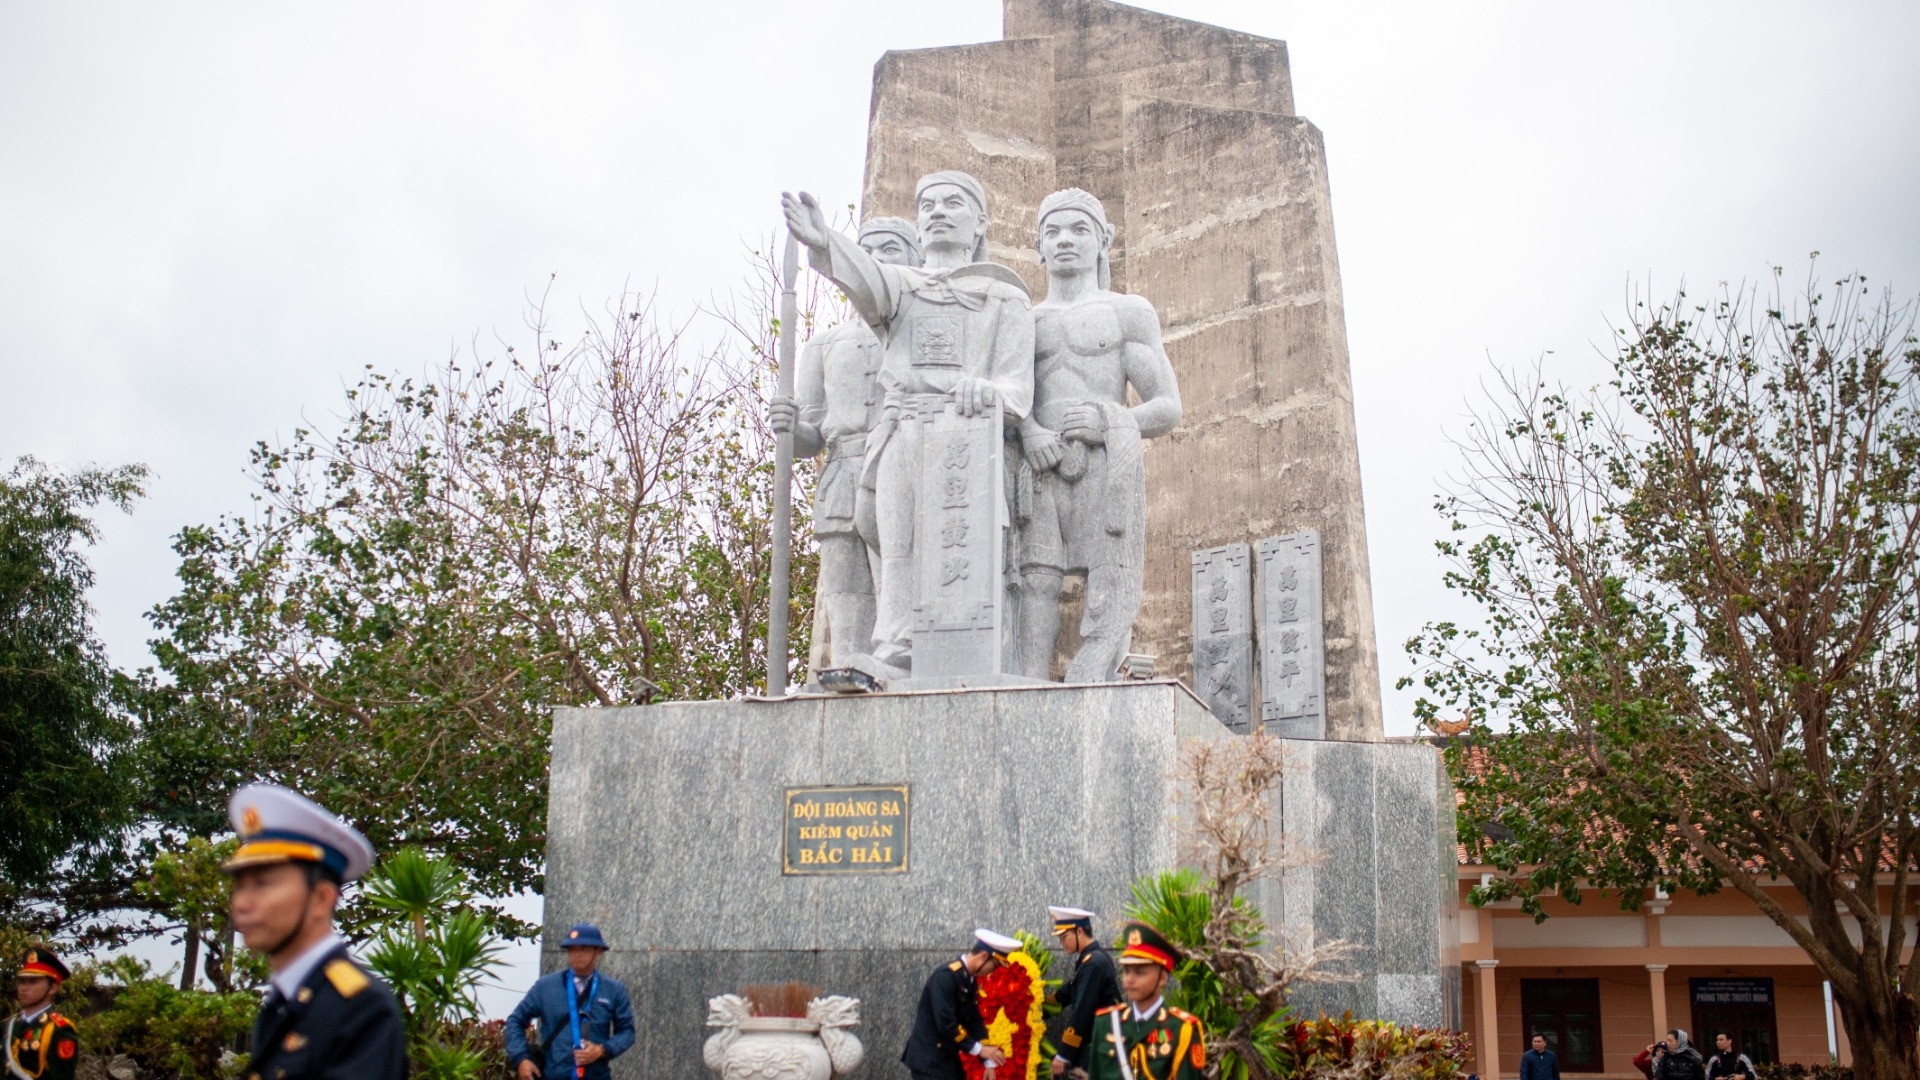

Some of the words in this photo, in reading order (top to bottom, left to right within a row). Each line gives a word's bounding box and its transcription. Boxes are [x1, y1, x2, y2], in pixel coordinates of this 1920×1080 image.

[793, 799, 820, 821] ĐỘI
[824, 797, 877, 817] HOÀNG
[880, 801, 900, 816] SA
[799, 823, 842, 839] KIÊM
[845, 820, 893, 840] QUẢN
[799, 841, 843, 864] BẮC
[851, 841, 892, 863] HẢI
